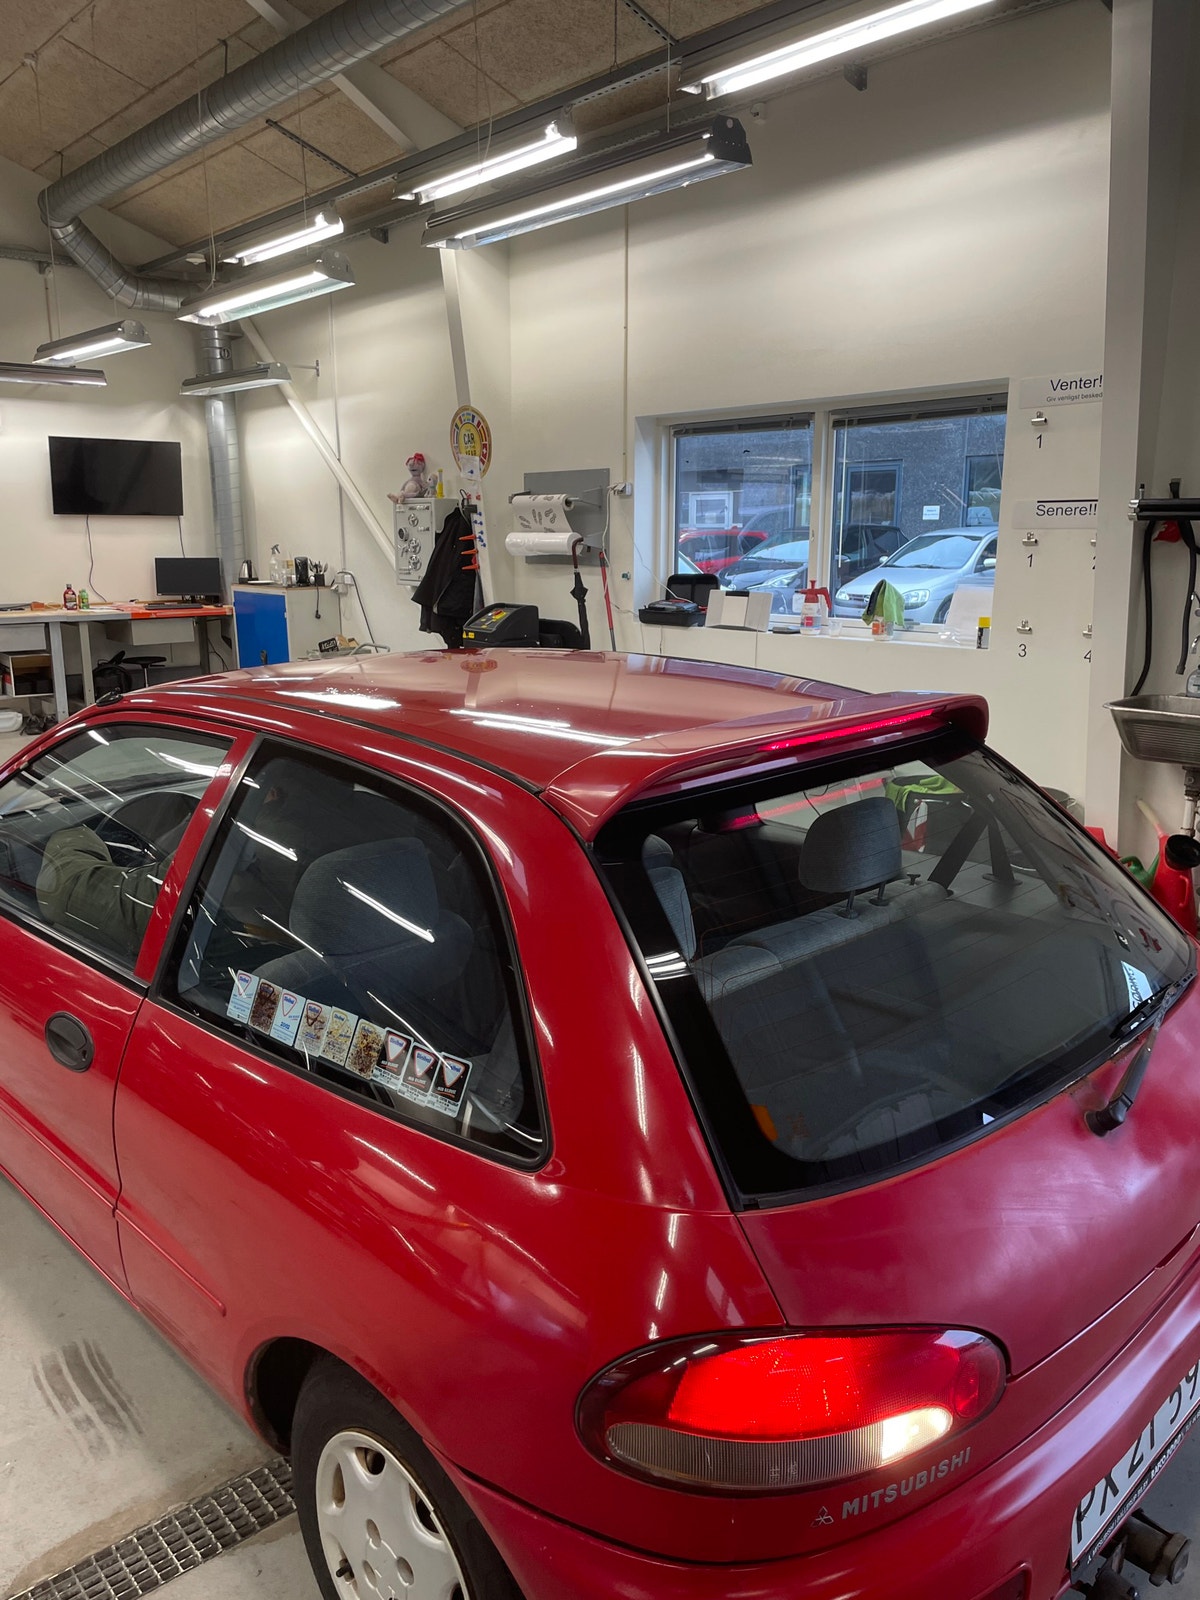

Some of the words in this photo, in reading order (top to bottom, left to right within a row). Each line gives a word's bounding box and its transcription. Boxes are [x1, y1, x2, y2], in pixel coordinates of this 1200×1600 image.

[1050, 375, 1103, 391] Venter!
[1058, 393, 1080, 402] venligst
[1081, 392, 1103, 400] besked
[463, 433, 476, 445] CAR
[1036, 433, 1042, 449] 1
[1036, 503, 1097, 516] Senere!!
[1027, 553, 1033, 568] 1
[1018, 643, 1027, 658] 3
[1083, 649, 1092, 663] 4
[841, 1447, 971, 1519] MITSUBISHI
